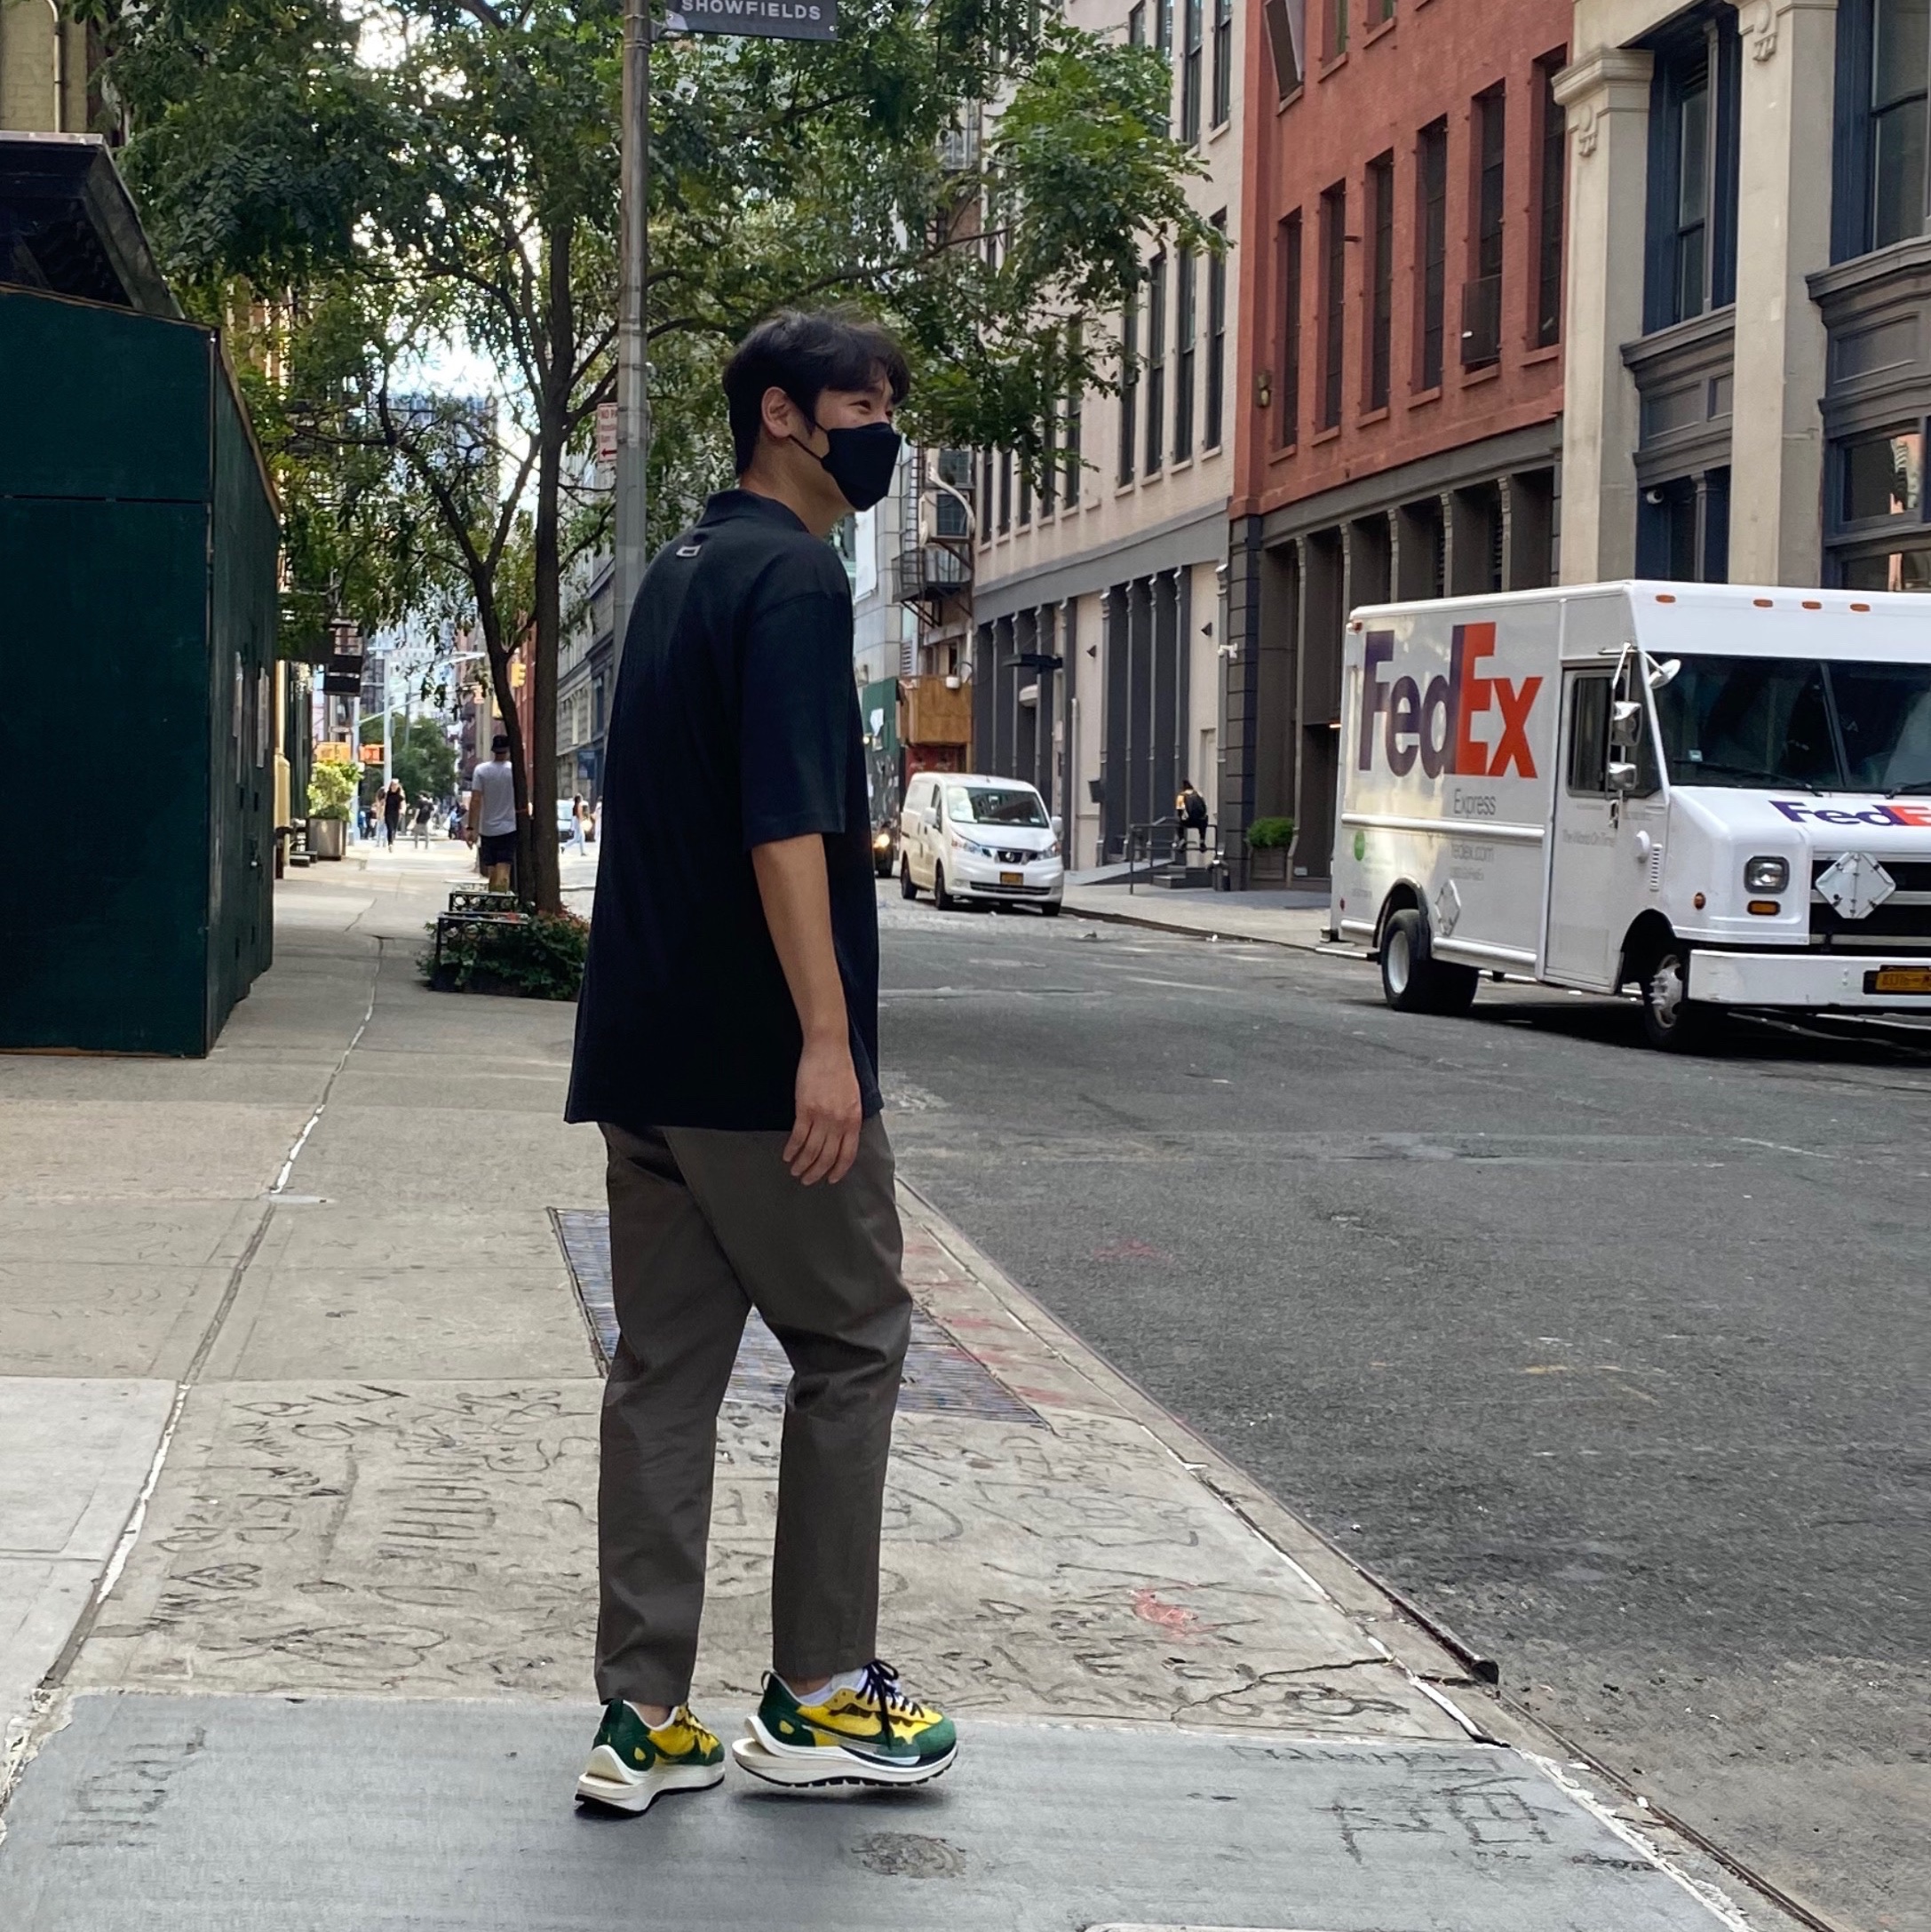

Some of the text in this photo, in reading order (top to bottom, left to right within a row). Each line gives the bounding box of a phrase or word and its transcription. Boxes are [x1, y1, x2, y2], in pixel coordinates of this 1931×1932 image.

[680, 0, 822, 20] SHOWFIELDS
[1359, 622, 1544, 778] FedEx
[1453, 788, 1497, 818] Express
[1768, 800, 1931, 826] FedE
